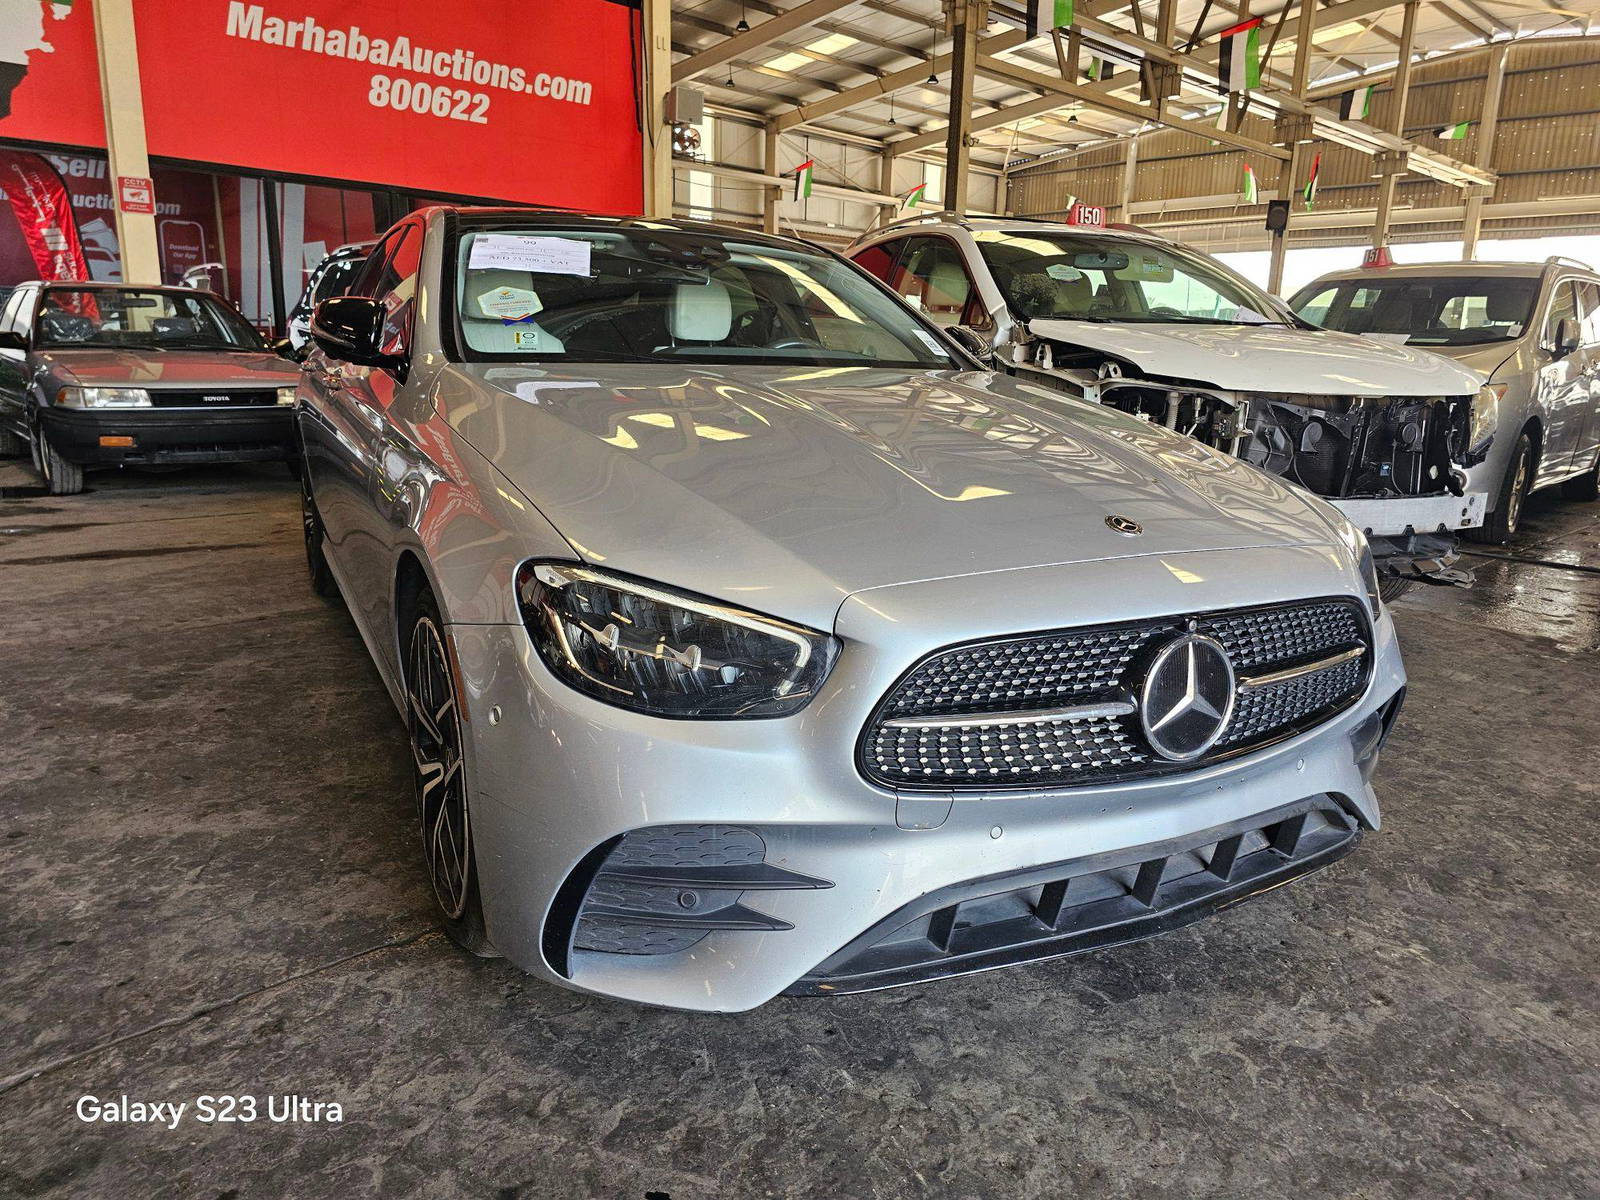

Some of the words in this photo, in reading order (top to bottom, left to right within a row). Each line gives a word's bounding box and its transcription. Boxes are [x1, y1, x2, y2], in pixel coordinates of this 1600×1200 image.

[226, 1, 592, 105] MarhabaAuctions.com
[368, 75, 490, 124] 800622
[52, 155, 106, 179] Sell
[124, 178, 147, 186] CCTV
[1079, 206, 1101, 225] 150
[1364, 249, 1379, 262] 151
